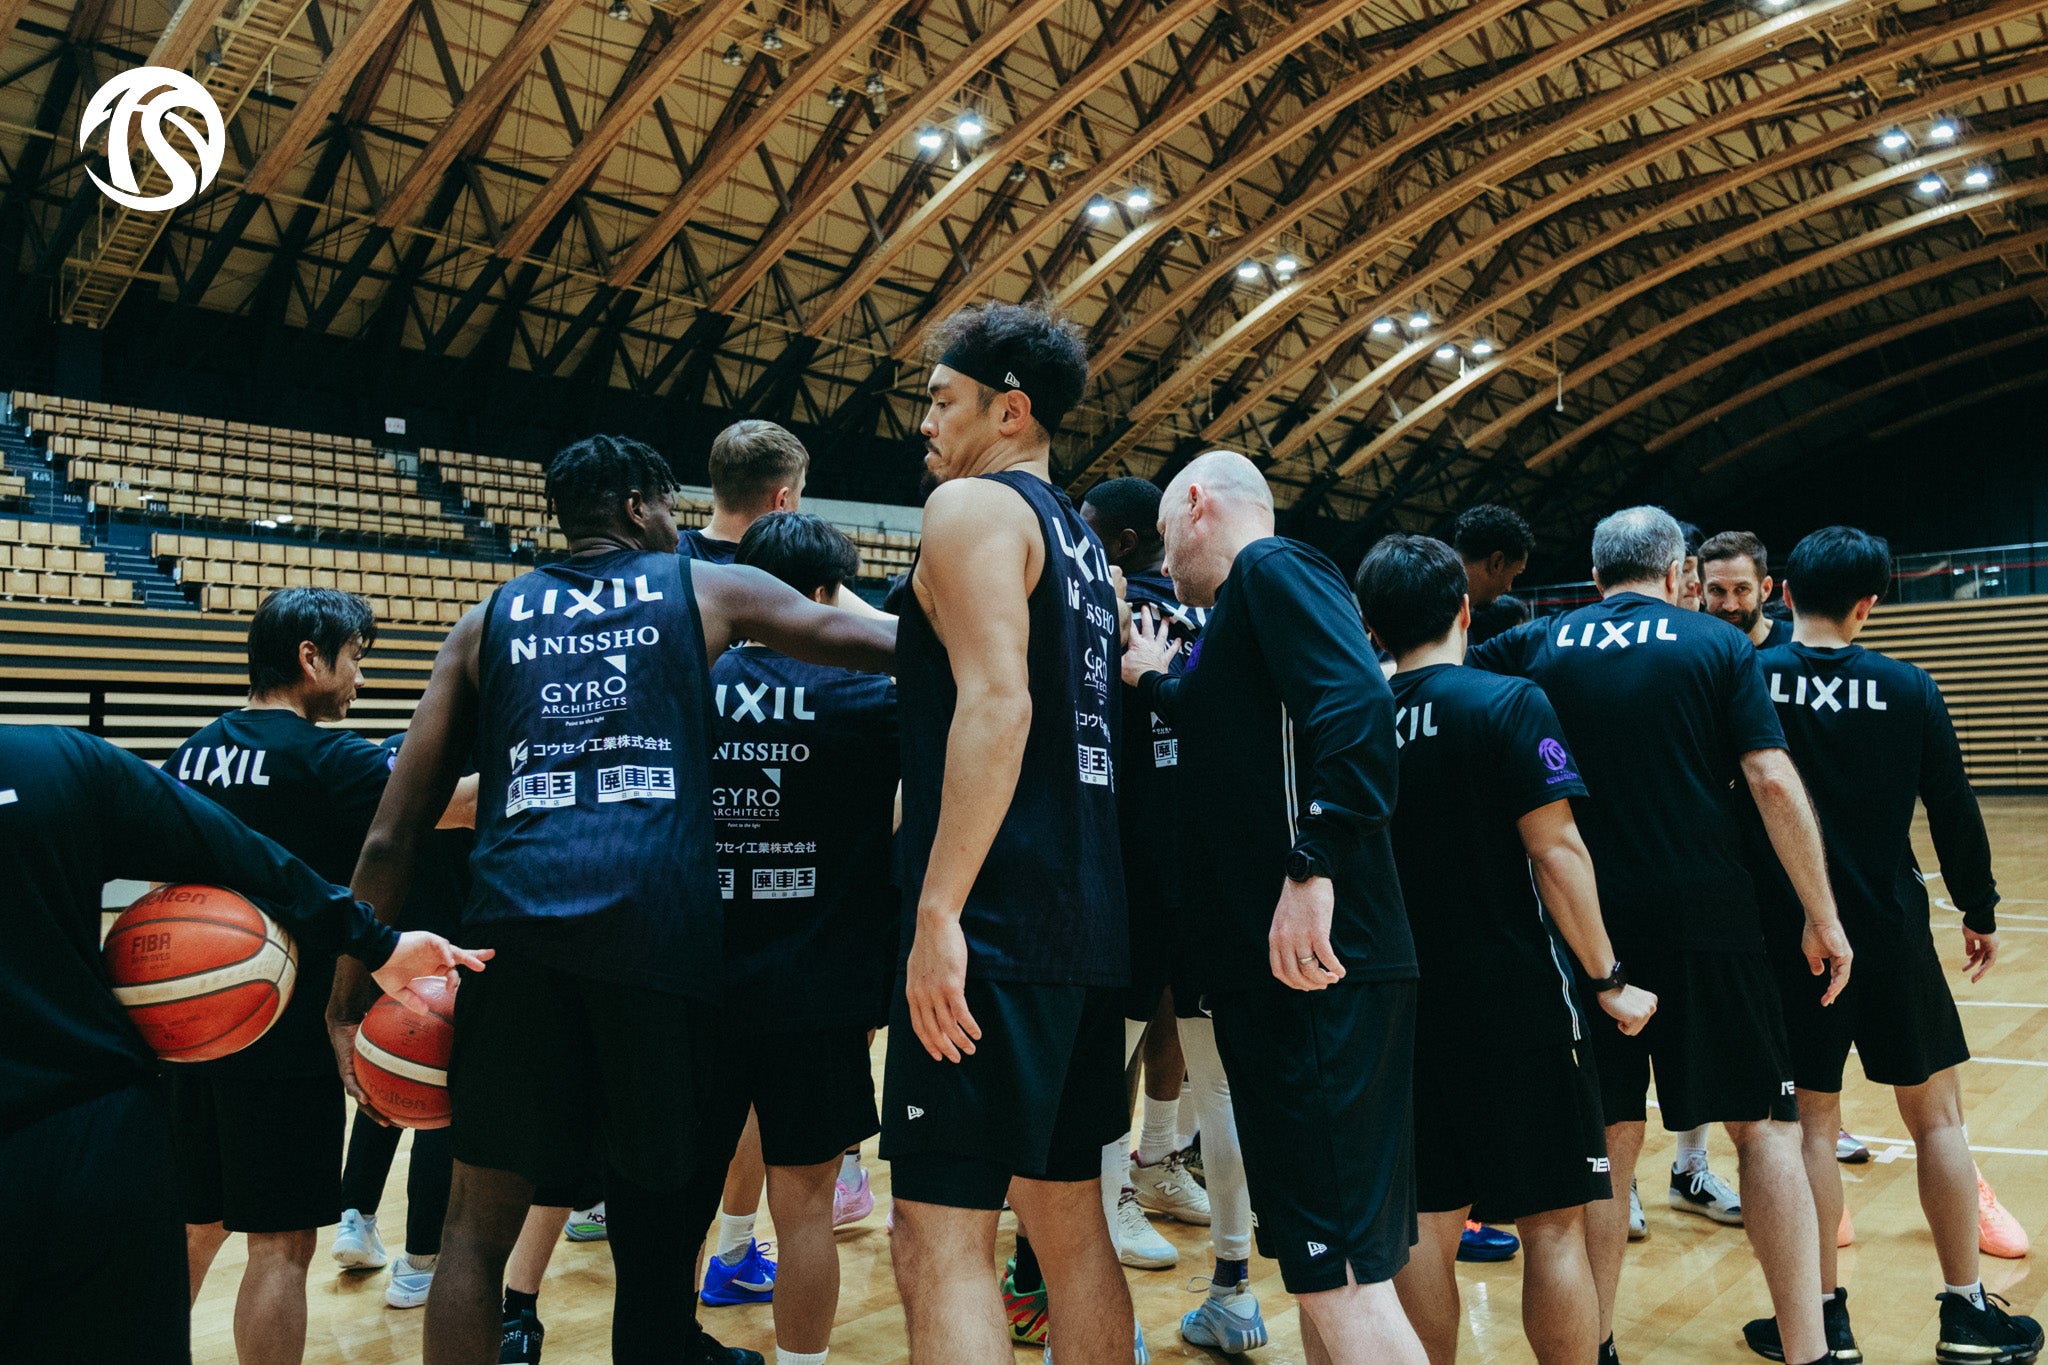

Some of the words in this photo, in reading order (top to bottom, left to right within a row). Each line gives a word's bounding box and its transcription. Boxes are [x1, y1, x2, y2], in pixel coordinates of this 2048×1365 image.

[510, 574, 664, 621] LIXIL
[542, 626, 660, 655] NISSHO
[1556, 618, 1678, 650] LIXIL
[541, 676, 627, 703] GYRO
[715, 682, 815, 723] IXIL
[1770, 672, 1887, 713] LIXIL
[541, 697, 627, 715] ARCHITECTS
[1396, 701, 1438, 749] XIL
[533, 734, 672, 757] コウセイ工業株式会社
[712, 742, 810, 762] NISSHO
[178, 744, 270, 789] LIXIL
[712, 787, 780, 807] GYRO
[715, 841, 817, 854] ウセイ工業株式会社
[131, 932, 171, 955] FIBA
